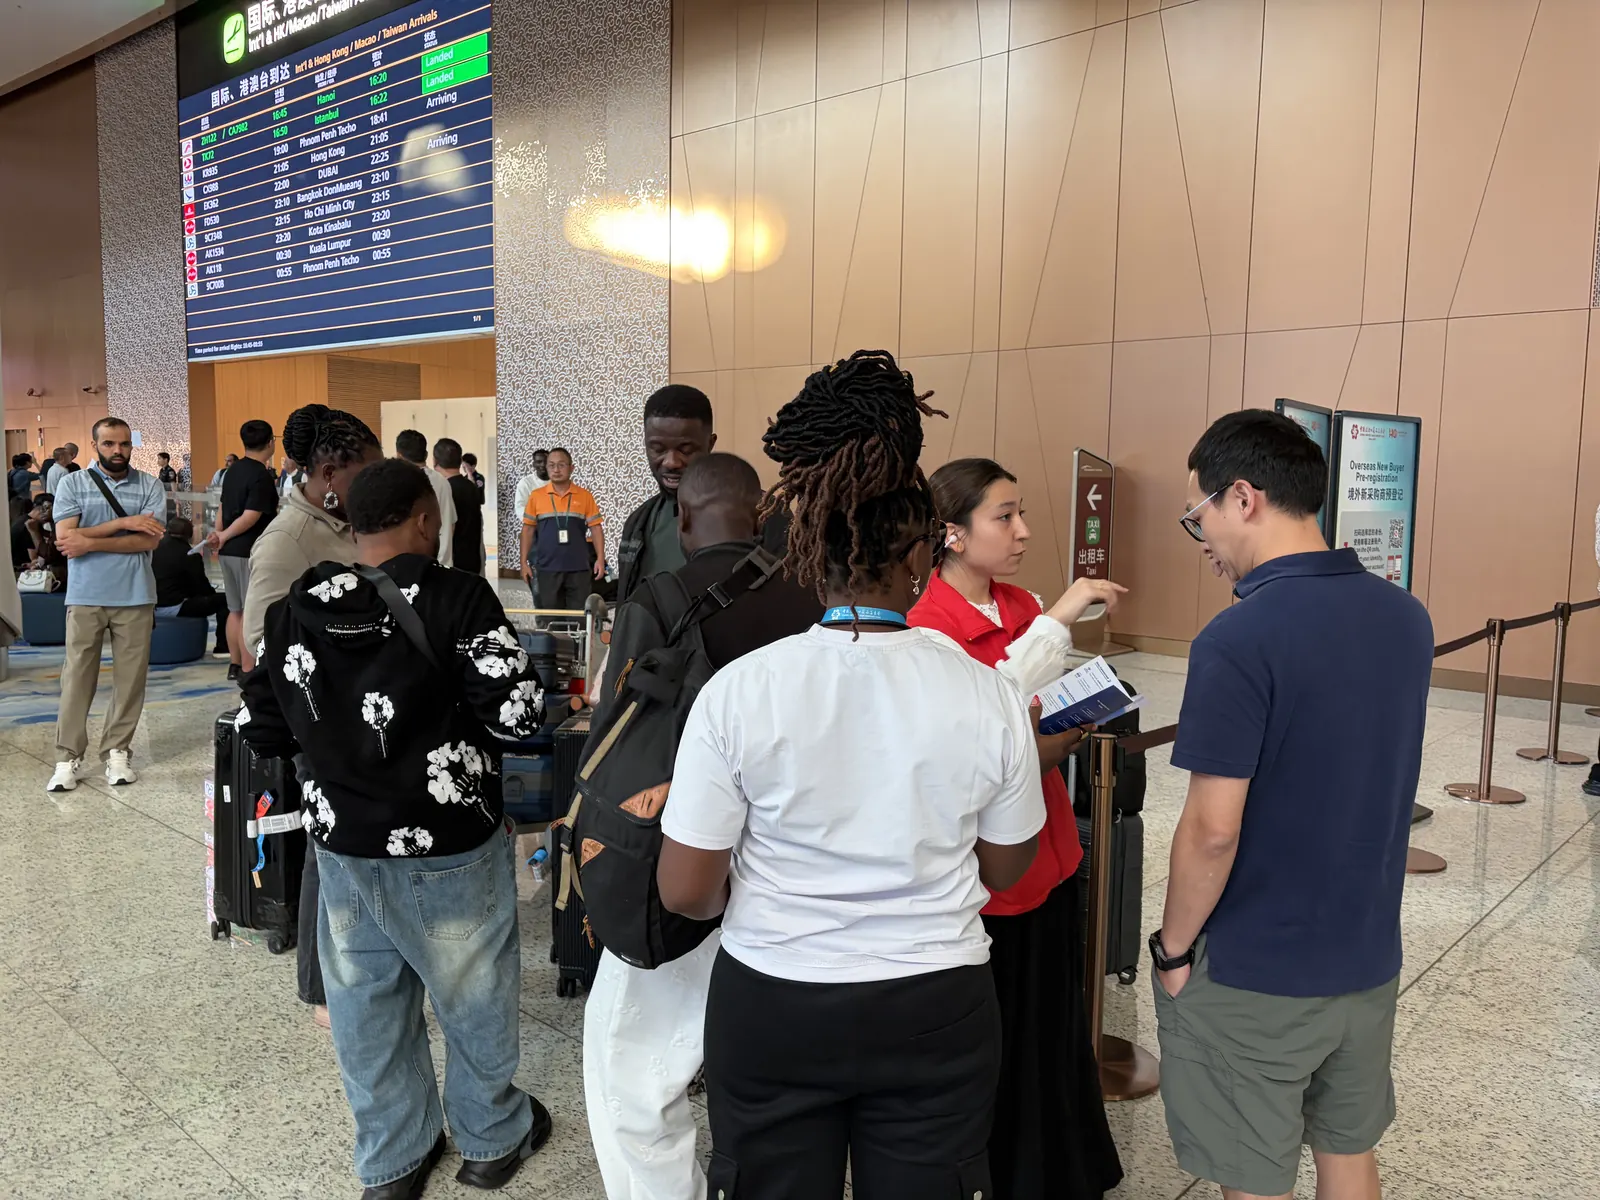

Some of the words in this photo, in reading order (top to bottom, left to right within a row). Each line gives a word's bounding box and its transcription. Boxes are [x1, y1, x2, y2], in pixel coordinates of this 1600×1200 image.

[248, 33, 265, 53] Int'l
[265, 31, 273, 45] &
[273, 0, 354, 42] HK/Macao/Taiwan
[295, 60, 308, 74] Int'l
[308, 58, 313, 69] &
[314, 53, 331, 68] Hong
[332, 46, 349, 59] Kong
[354, 34, 376, 50] Macao
[382, 22, 408, 39] Taiwan
[409, 9, 438, 30] Arrivals
[425, 47, 454, 67] Landed
[211, 61, 291, 109] 国际、港澳台到达
[369, 71, 388, 87] 16:20
[425, 68, 454, 88] Landed
[317, 90, 336, 105] Hanoi
[369, 91, 388, 106] 16:22
[426, 91, 457, 109] Arriving
[272, 107, 288, 121] 16:45
[314, 107, 339, 125] Istanbul
[369, 111, 388, 126] 18:41
[272, 125, 288, 139] 16:50
[299, 134, 321, 148] Phnom
[321, 129, 337, 142] Penh
[338, 122, 357, 136] Techo
[369, 130, 389, 146] 21:05
[427, 133, 458, 150] Arriving
[201, 150, 215, 162] TK72
[273, 143, 289, 156] 19:00
[310, 151, 328, 163] Hong
[328, 146, 346, 158] Kong
[370, 150, 390, 165] 22:25
[273, 161, 289, 174] 21:05
[318, 165, 339, 179] DUBAI
[370, 170, 390, 184] 23:10
[274, 178, 290, 192] 22:00
[296, 188, 323, 203] Bangkok
[323, 179, 363, 197] DonMueang
[274, 196, 290, 209] 23:10
[371, 190, 390, 204] 23:15
[304, 209, 313, 220] Ho
[314, 206, 325, 217] Chi
[325, 203, 342, 216] Minh
[342, 199, 355, 213] City
[371, 209, 391, 223] 23:20
[274, 214, 291, 226] 23:15
[308, 224, 323, 236] Kota
[324, 218, 352, 233] Kinabalu
[275, 231, 291, 244] 23:20
[372, 228, 391, 242] 00:30
[309, 241, 327, 254] Kuala
[327, 238, 352, 251] Lumpur
[275, 249, 292, 261] 00:30
[372, 248, 391, 260] 00:55
[302, 259, 324, 273] Phnom
[324, 257, 340, 270] Penh
[340, 254, 360, 266] Techo
[276, 266, 292, 278] 00:55
[1350, 460, 1376, 471] Overseas
[1377, 461, 1388, 471] New
[1388, 462, 1405, 473] Buyer
[1355, 472, 1399, 484] Pre-registration
[1348, 487, 1404, 501] 境外新采购商预登记
[1087, 520, 1100, 529] TAXI
[1078, 547, 1105, 565] 出租车
[1086, 566, 1097, 576] Taxi
